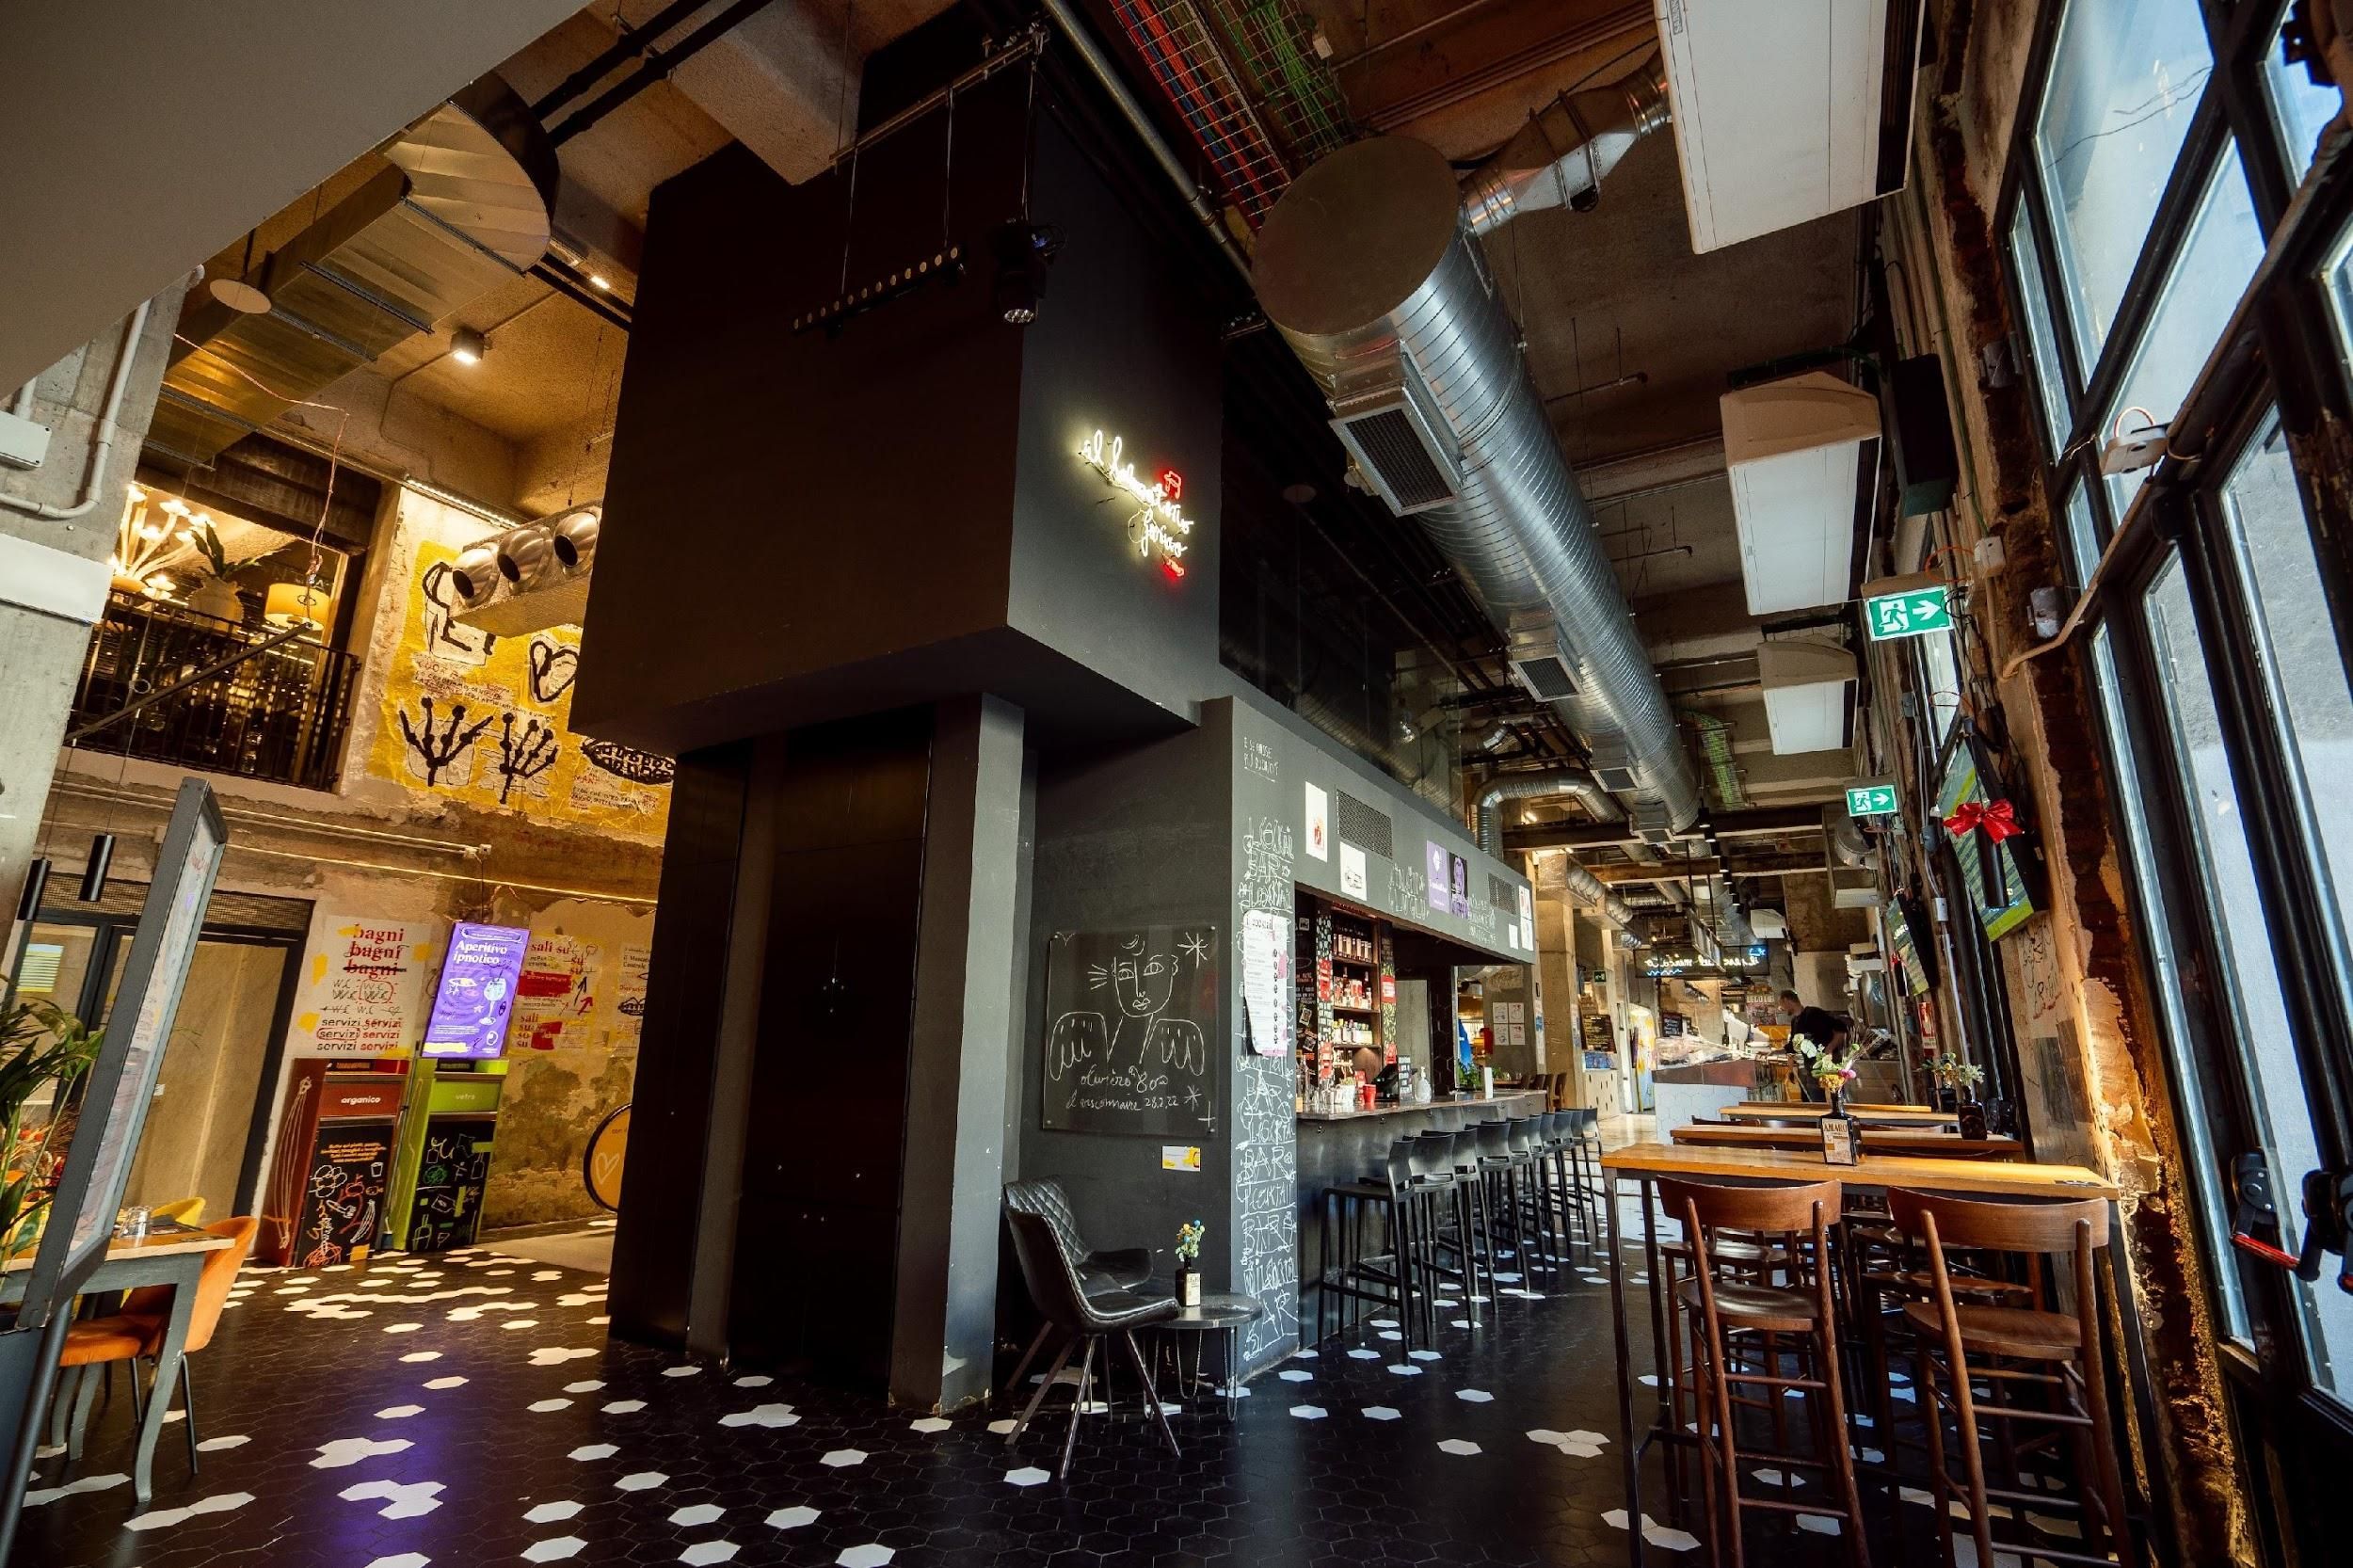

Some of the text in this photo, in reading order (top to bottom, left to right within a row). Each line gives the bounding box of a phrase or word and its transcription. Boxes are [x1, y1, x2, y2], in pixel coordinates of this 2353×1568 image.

[353, 922, 405, 945] bagni
[349, 940, 403, 962] bagni
[456, 939, 508, 955] Aperitivo
[531, 941, 553, 953] sali
[452, 951, 501, 965] ipnotico
[345, 958, 399, 980] bagni
[321, 1017, 402, 1029] servizi servizi
[319, 1028, 400, 1039] servizi servizi
[316, 1039, 398, 1051] servizi servizi
[341, 1095, 381, 1106] organico
[1823, 1123, 1848, 1133] AMARO
